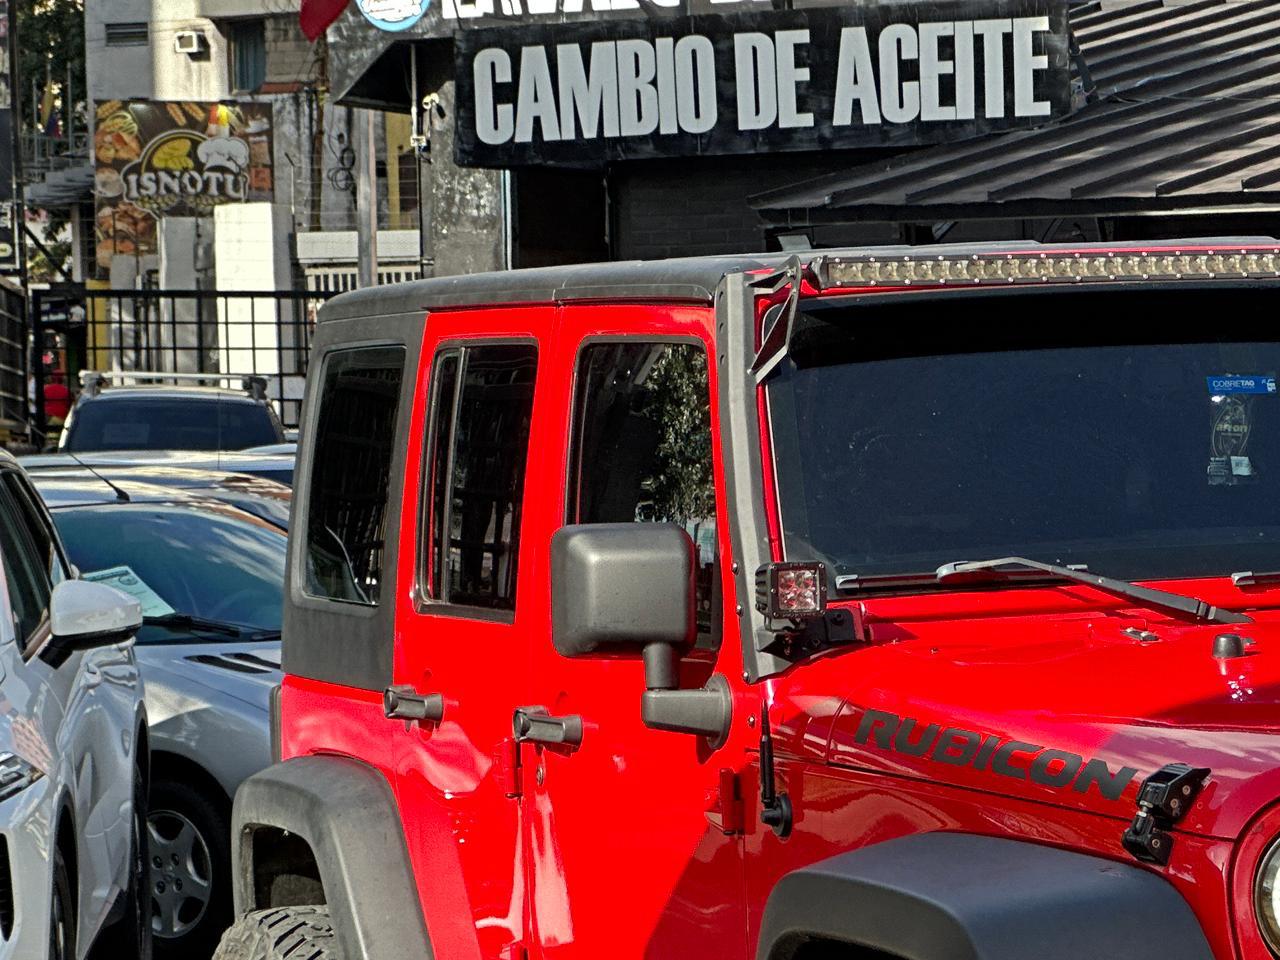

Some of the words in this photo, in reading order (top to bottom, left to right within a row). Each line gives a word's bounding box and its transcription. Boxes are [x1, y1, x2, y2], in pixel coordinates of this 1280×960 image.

[473, 35, 718, 146] CAMBIO
[734, 30, 815, 131] DE
[833, 16, 1051, 127] ACEITE
[855, 709, 1138, 801] RUBICON
